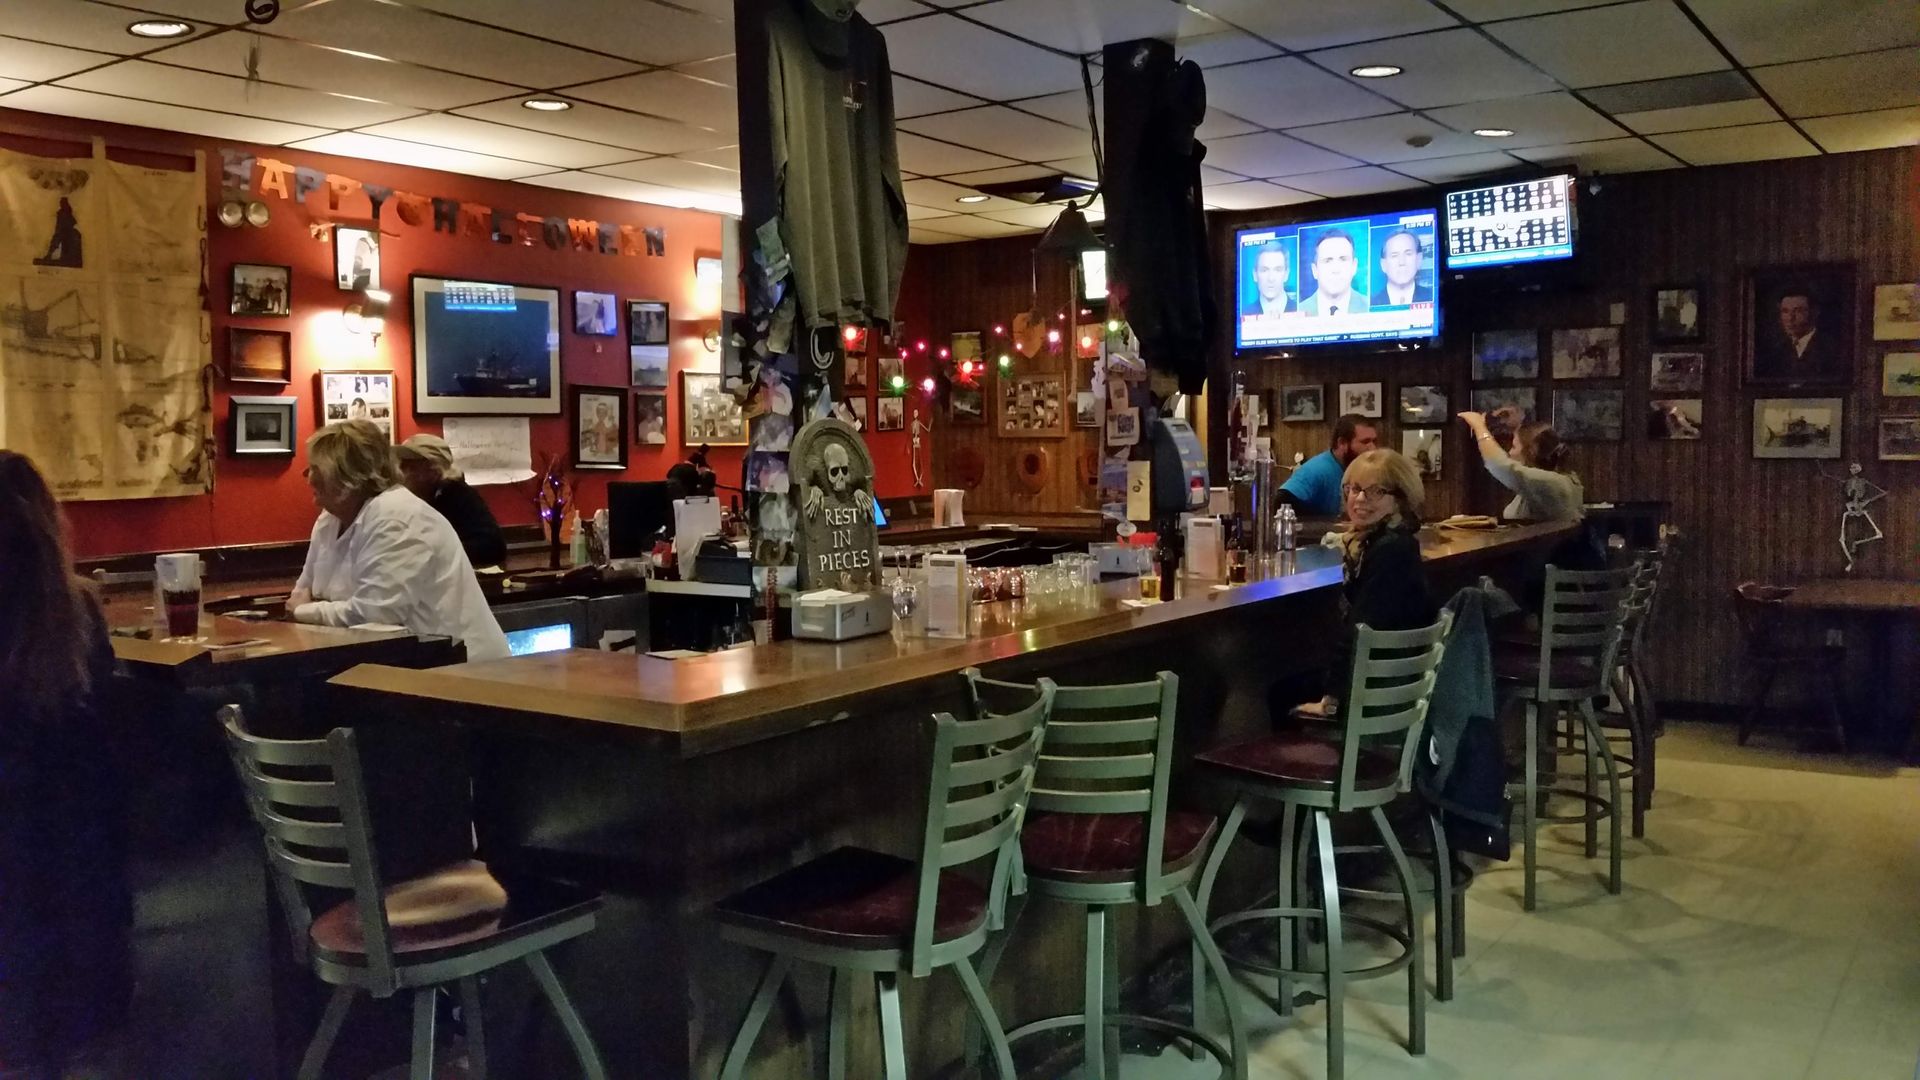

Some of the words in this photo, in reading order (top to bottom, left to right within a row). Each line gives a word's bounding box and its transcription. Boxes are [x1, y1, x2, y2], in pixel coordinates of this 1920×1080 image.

[219, 148, 395, 220] HAPPY
[824, 507, 858, 526] REST
[832, 529, 851, 549] IN
[818, 549, 870, 572] PIECES
